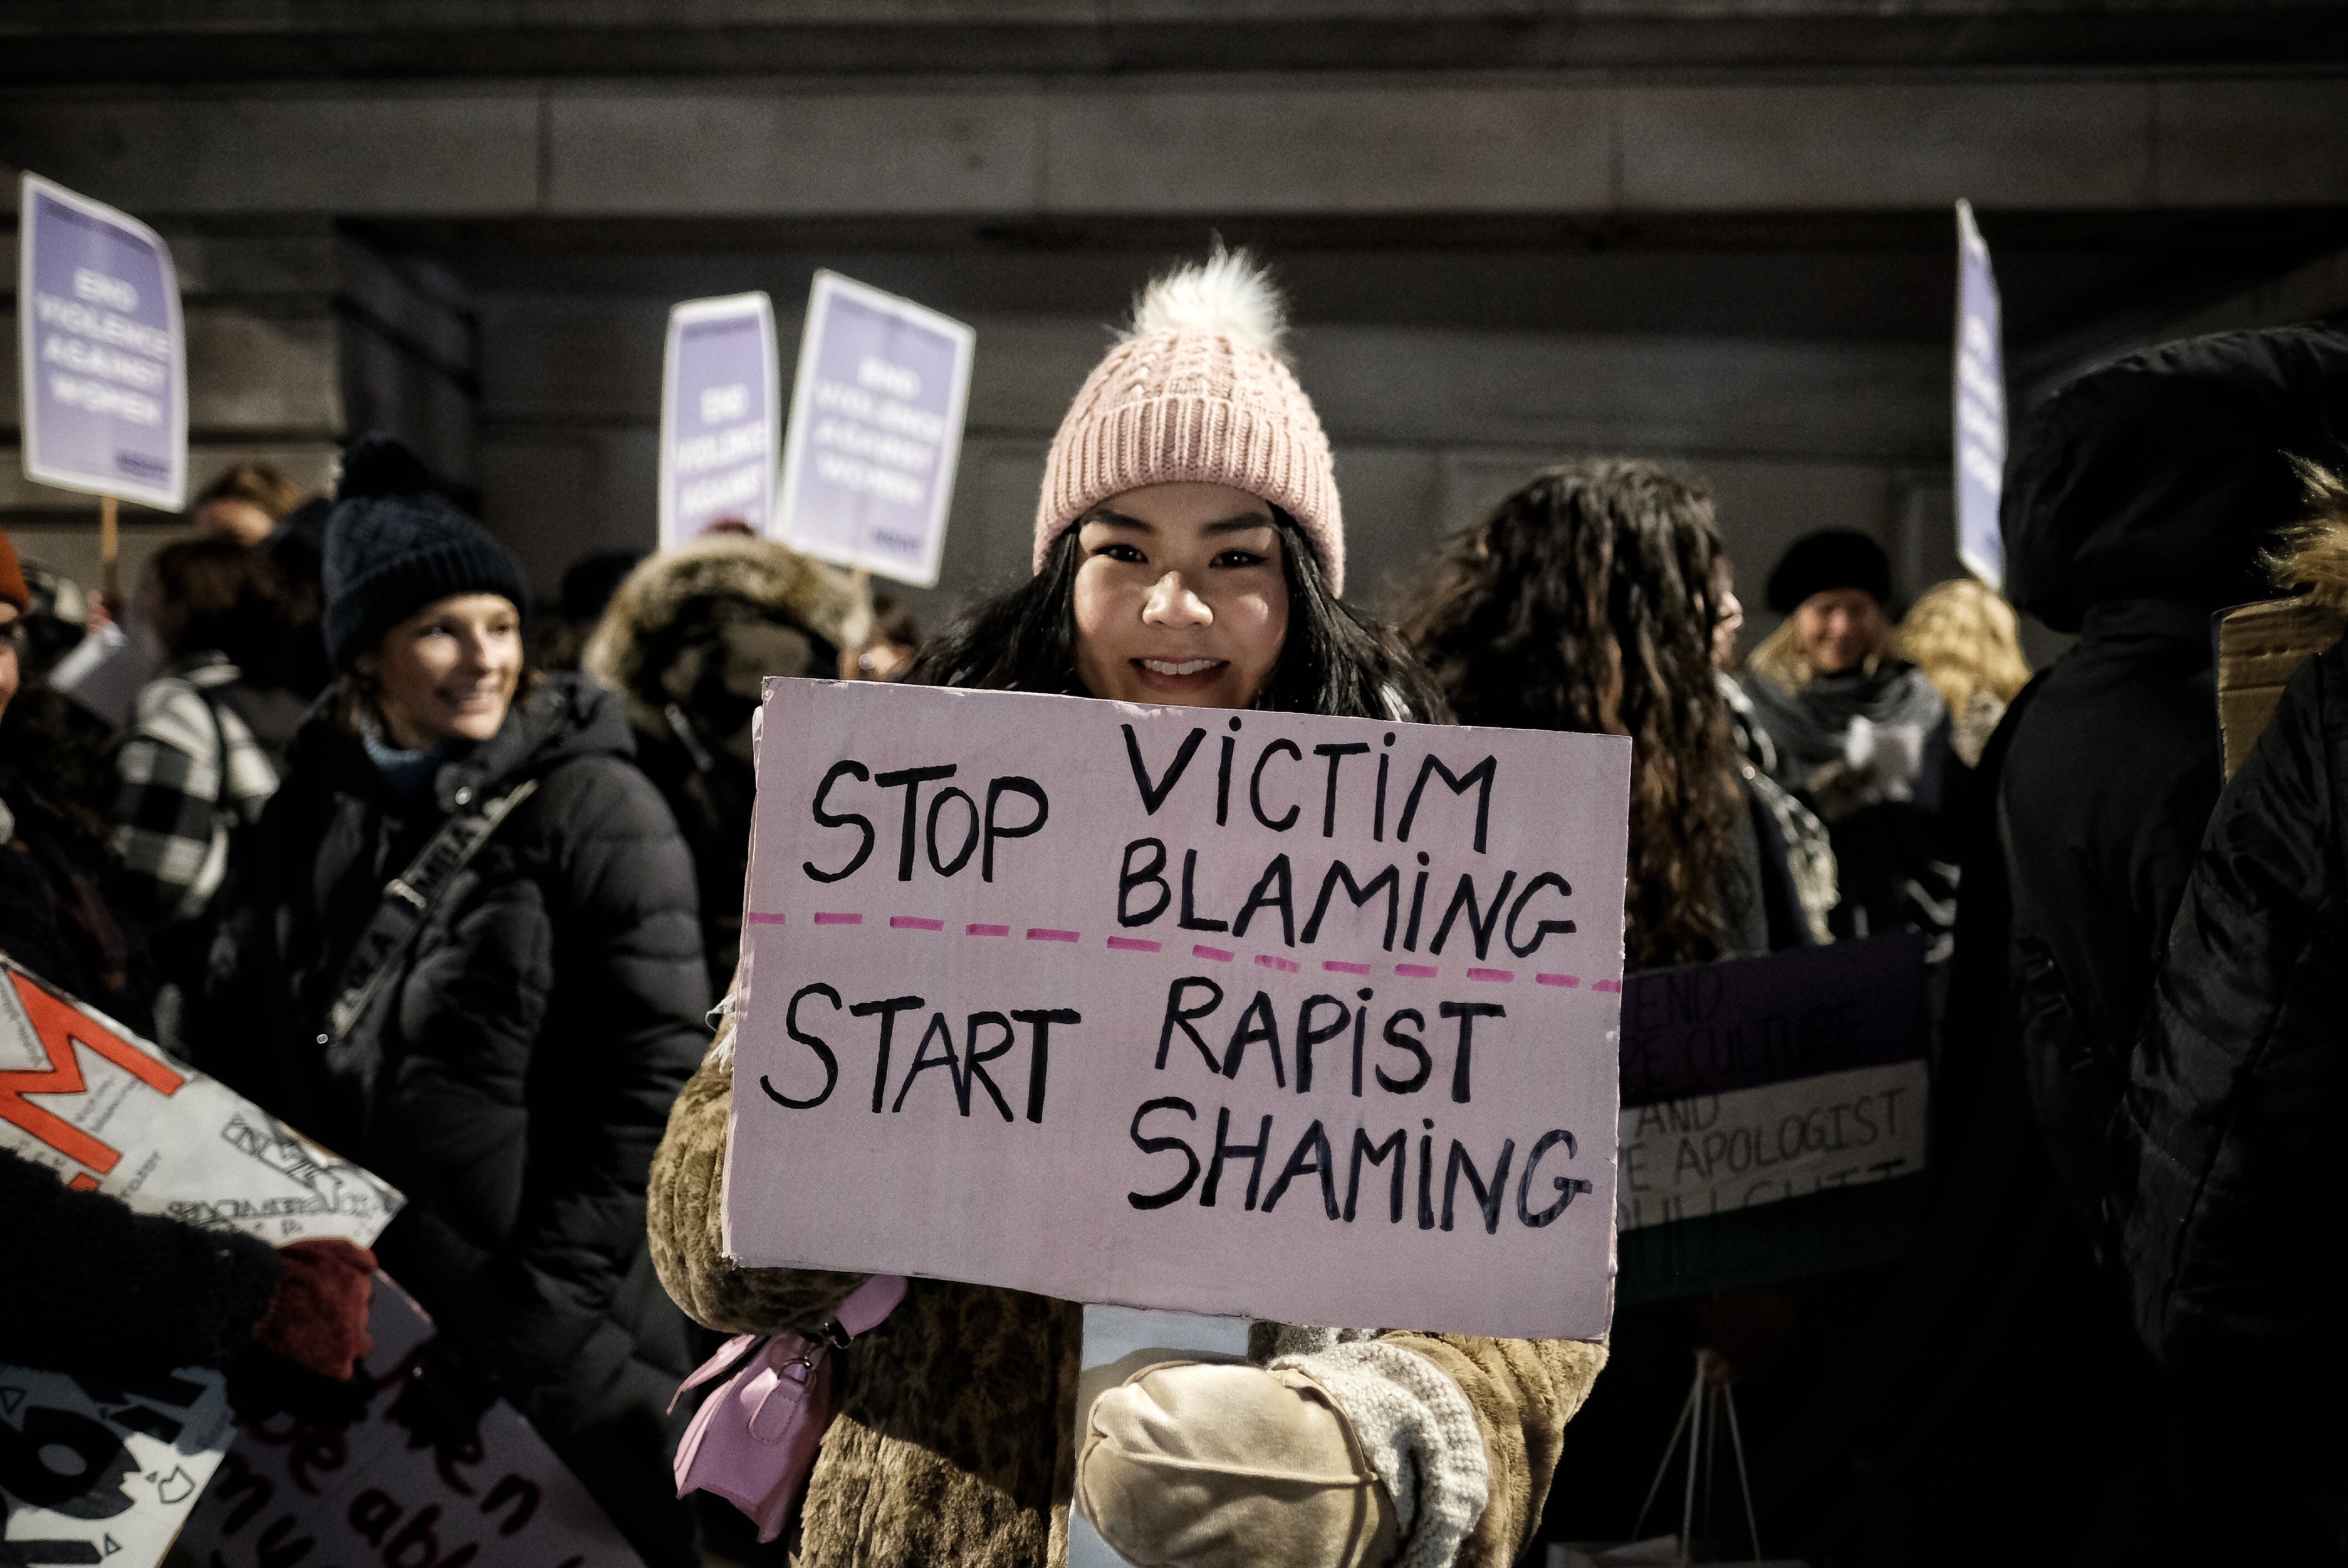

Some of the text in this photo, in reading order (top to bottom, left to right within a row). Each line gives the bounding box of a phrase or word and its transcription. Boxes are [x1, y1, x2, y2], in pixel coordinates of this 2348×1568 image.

[802, 760, 1048, 883] STOP
[760, 983, 1081, 1123] START
[1635, 1085, 1719, 1137] AND
[1674, 1086, 1907, 1183] APOLOGIST
